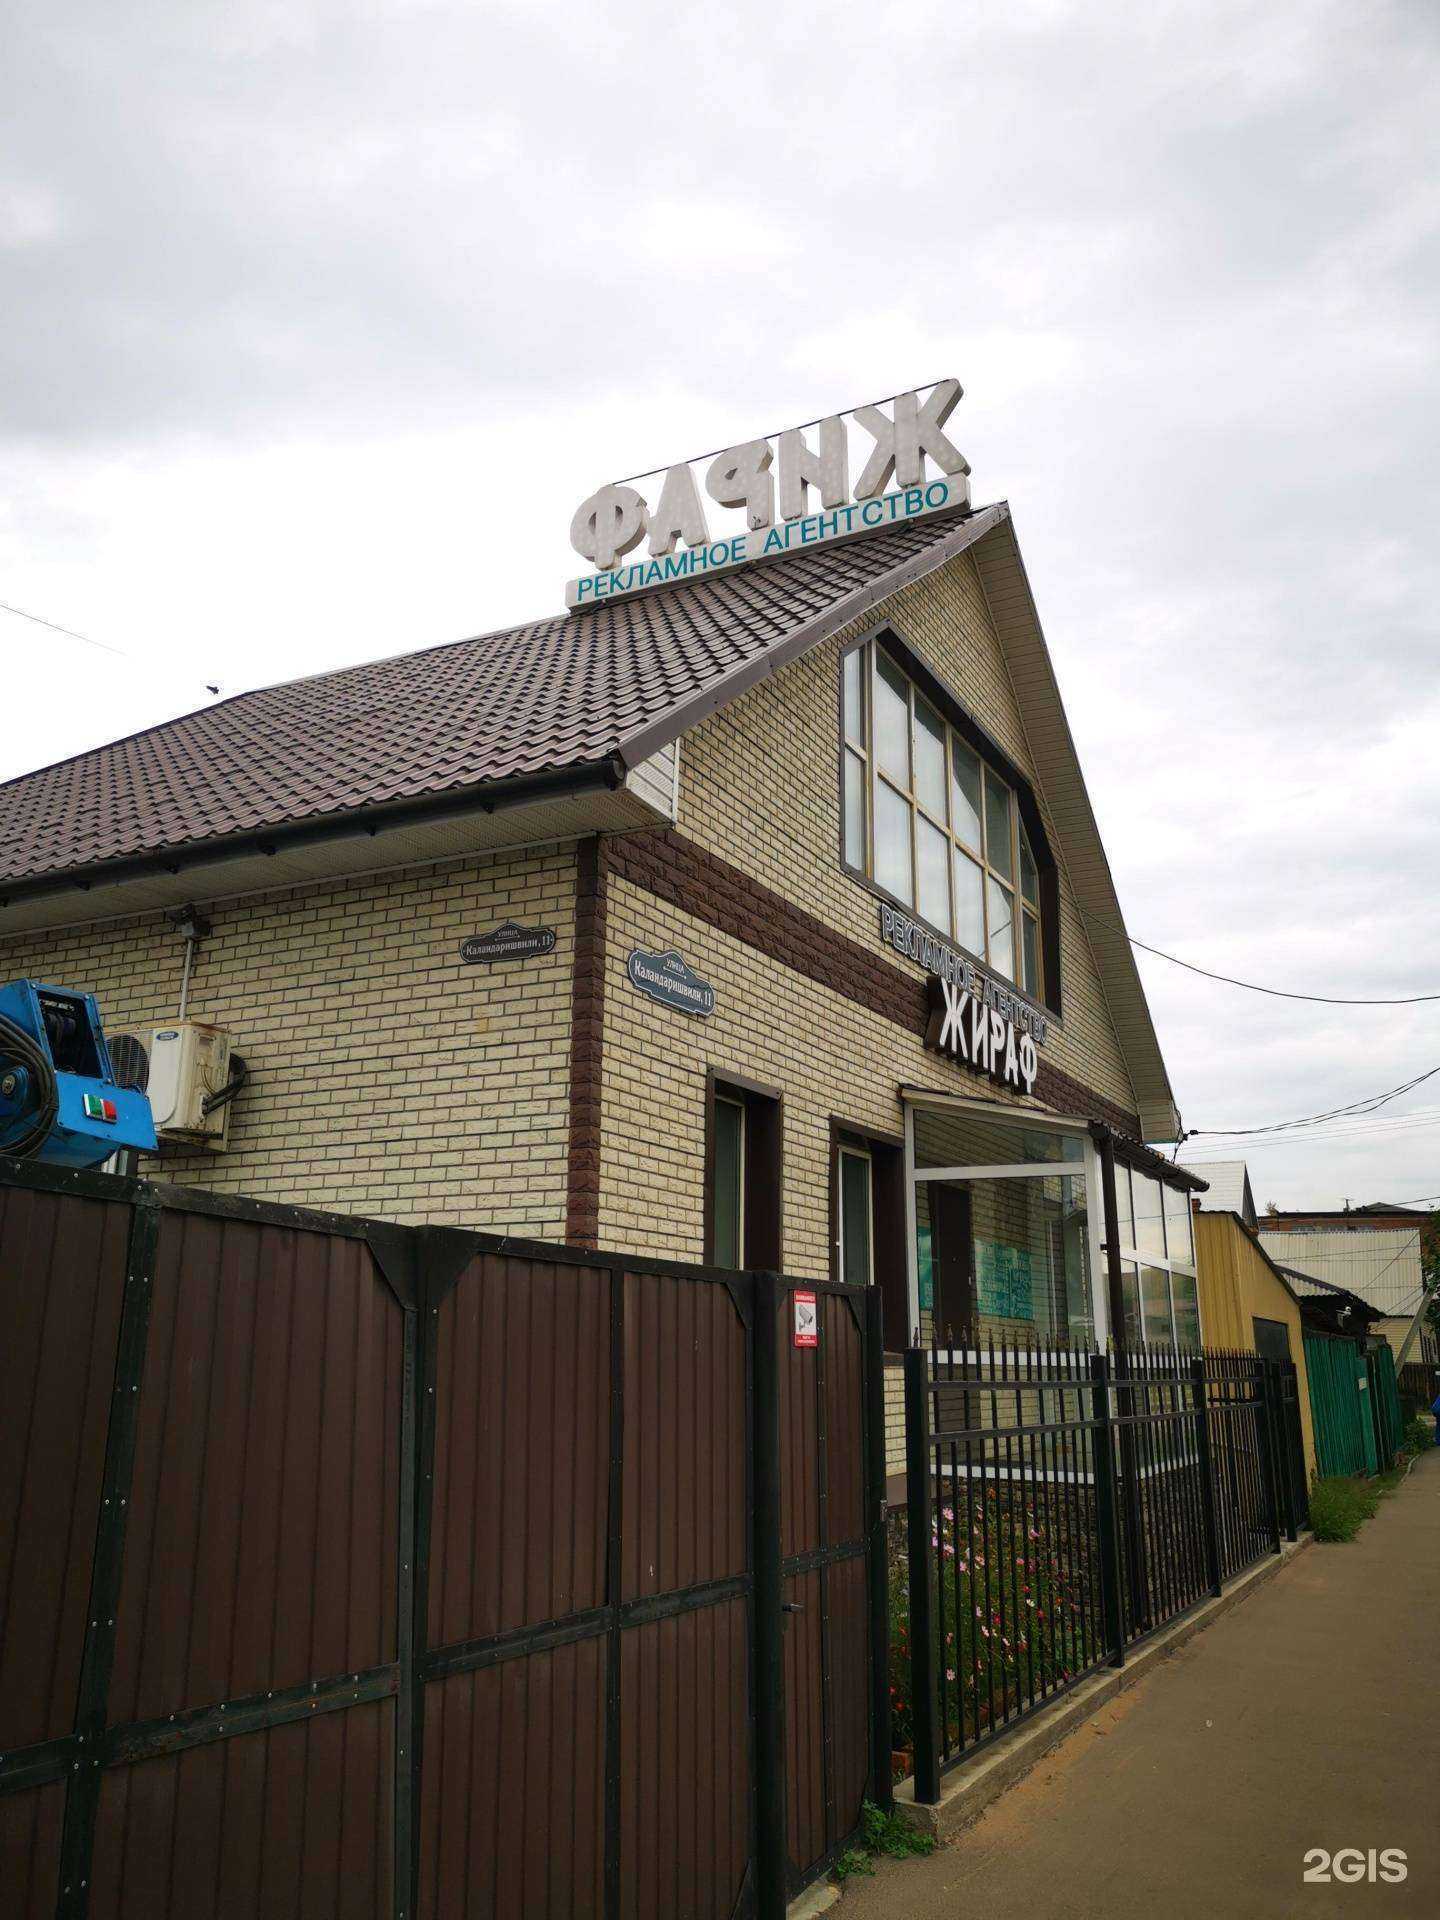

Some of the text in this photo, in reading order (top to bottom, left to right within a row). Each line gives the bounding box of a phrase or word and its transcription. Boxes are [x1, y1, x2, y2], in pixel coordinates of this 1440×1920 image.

[577, 481, 950, 602] РЕКЛАМНОЕ АГЕНТСТВО
[881, 903, 976, 995] РЕКЛАМНОЕ
[939, 977, 1037, 1094] ЖИРАФ
